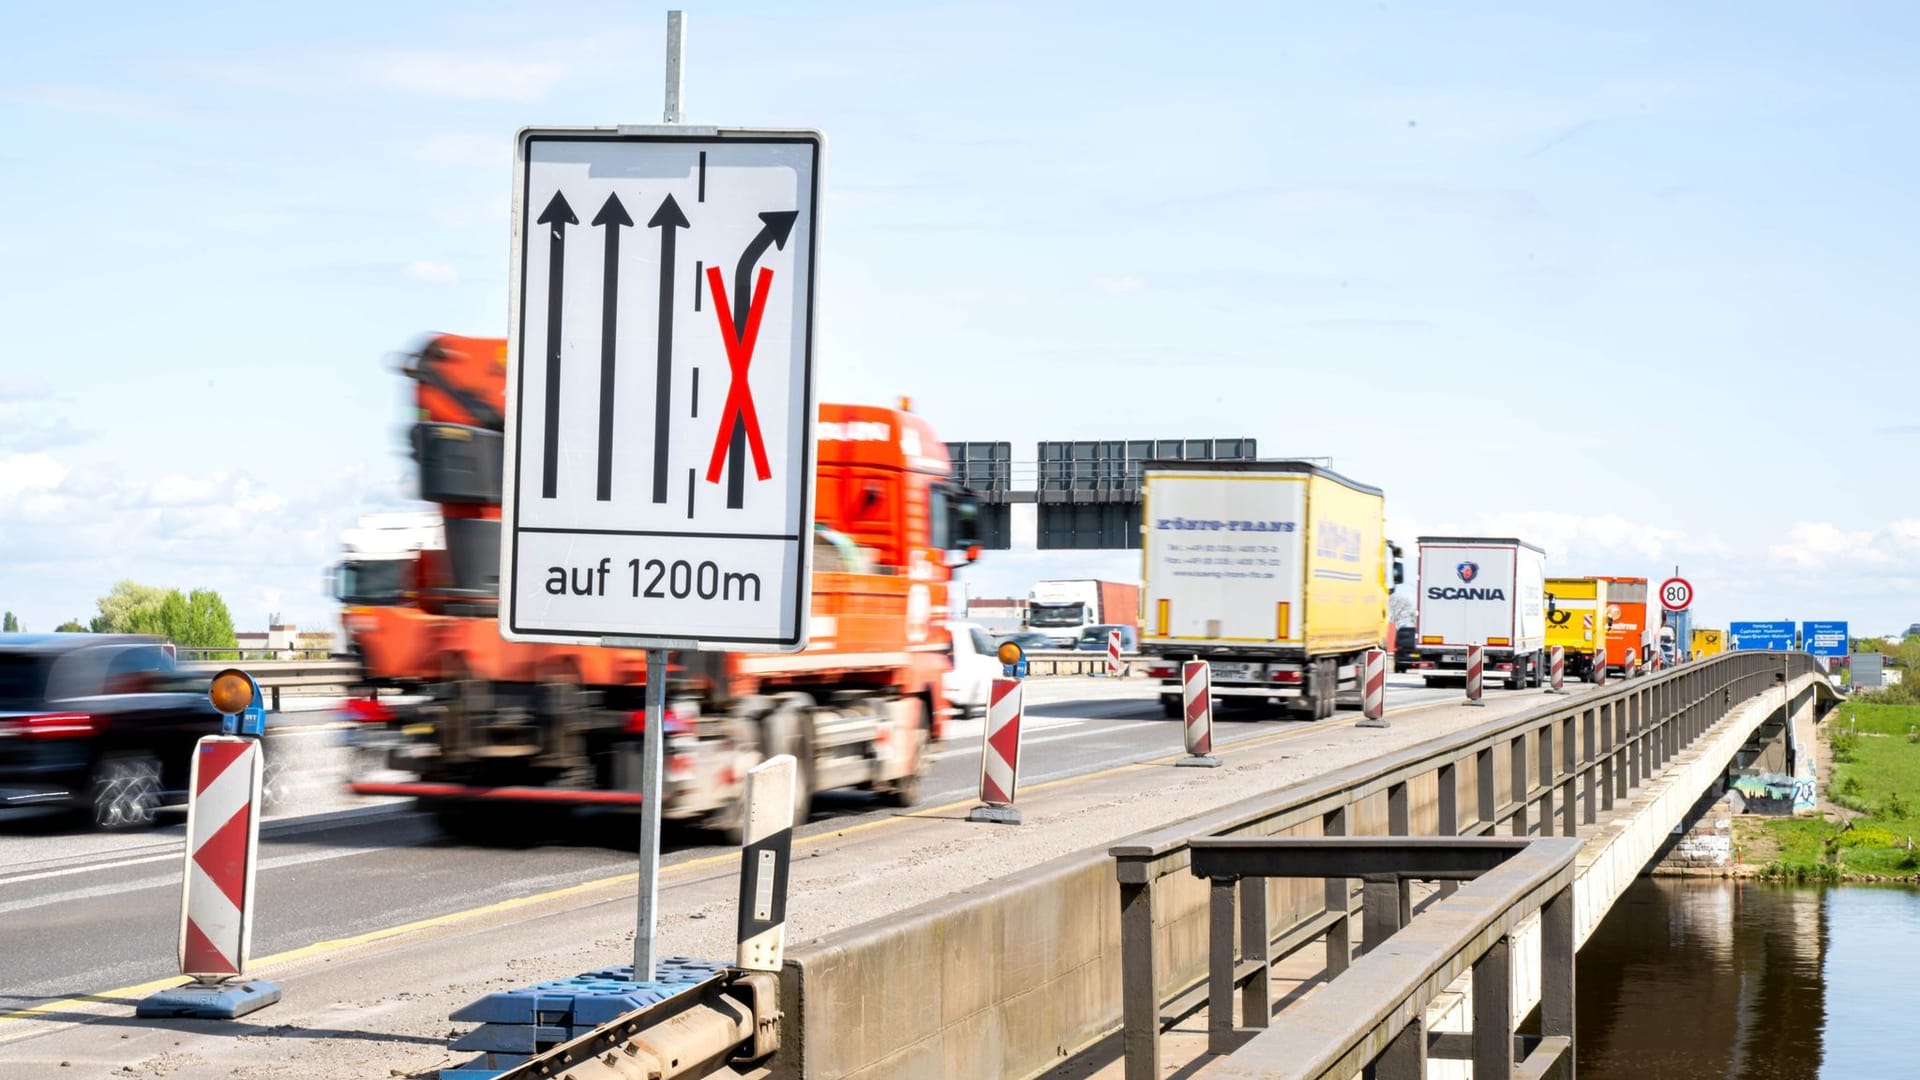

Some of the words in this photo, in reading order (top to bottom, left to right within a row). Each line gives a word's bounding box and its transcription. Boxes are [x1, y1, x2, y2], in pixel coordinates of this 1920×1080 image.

[545, 557, 611, 596] auf
[628, 558, 761, 602] 1200m
[1427, 587, 1505, 601] SCANIA
[1667, 586, 1686, 601] 80
